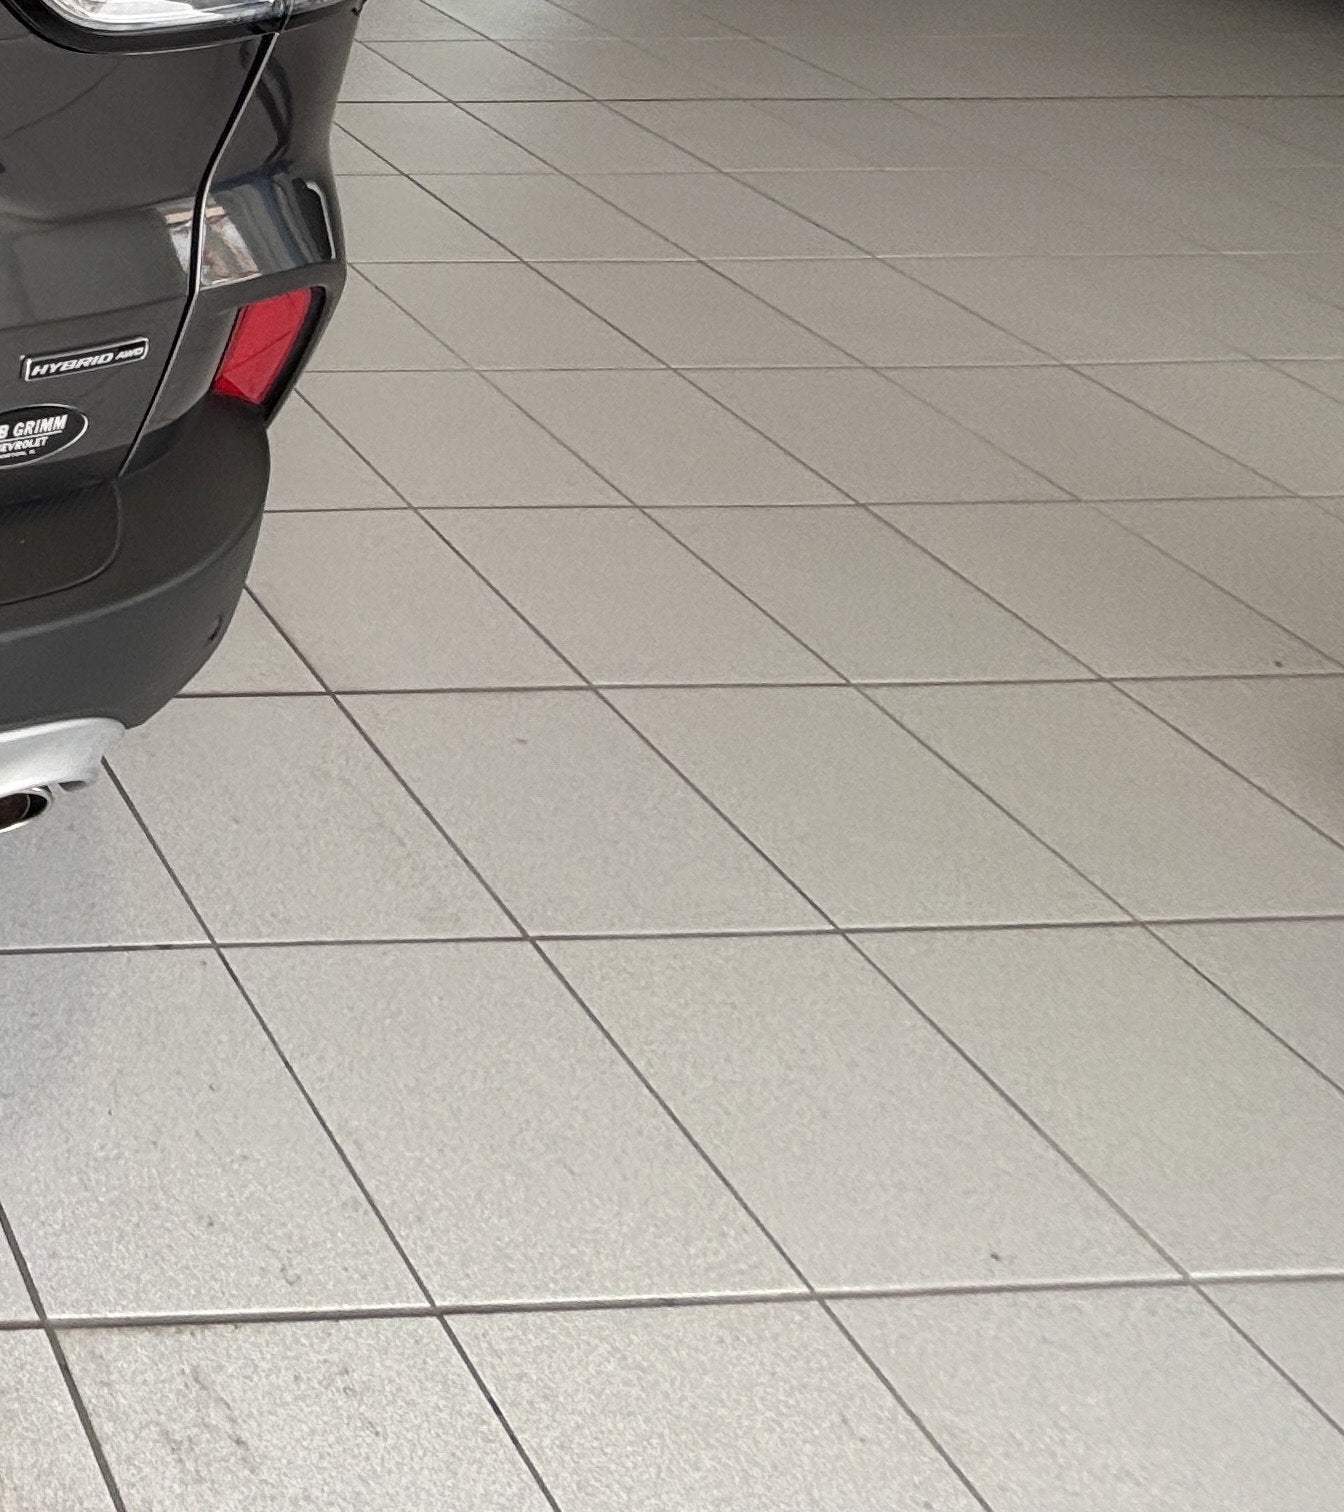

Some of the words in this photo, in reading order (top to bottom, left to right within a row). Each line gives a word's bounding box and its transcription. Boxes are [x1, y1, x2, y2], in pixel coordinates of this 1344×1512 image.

[31, 352, 115, 376] HYBRID
[115, 346, 144, 361] AWD
[13, 414, 69, 437] GRIMM
